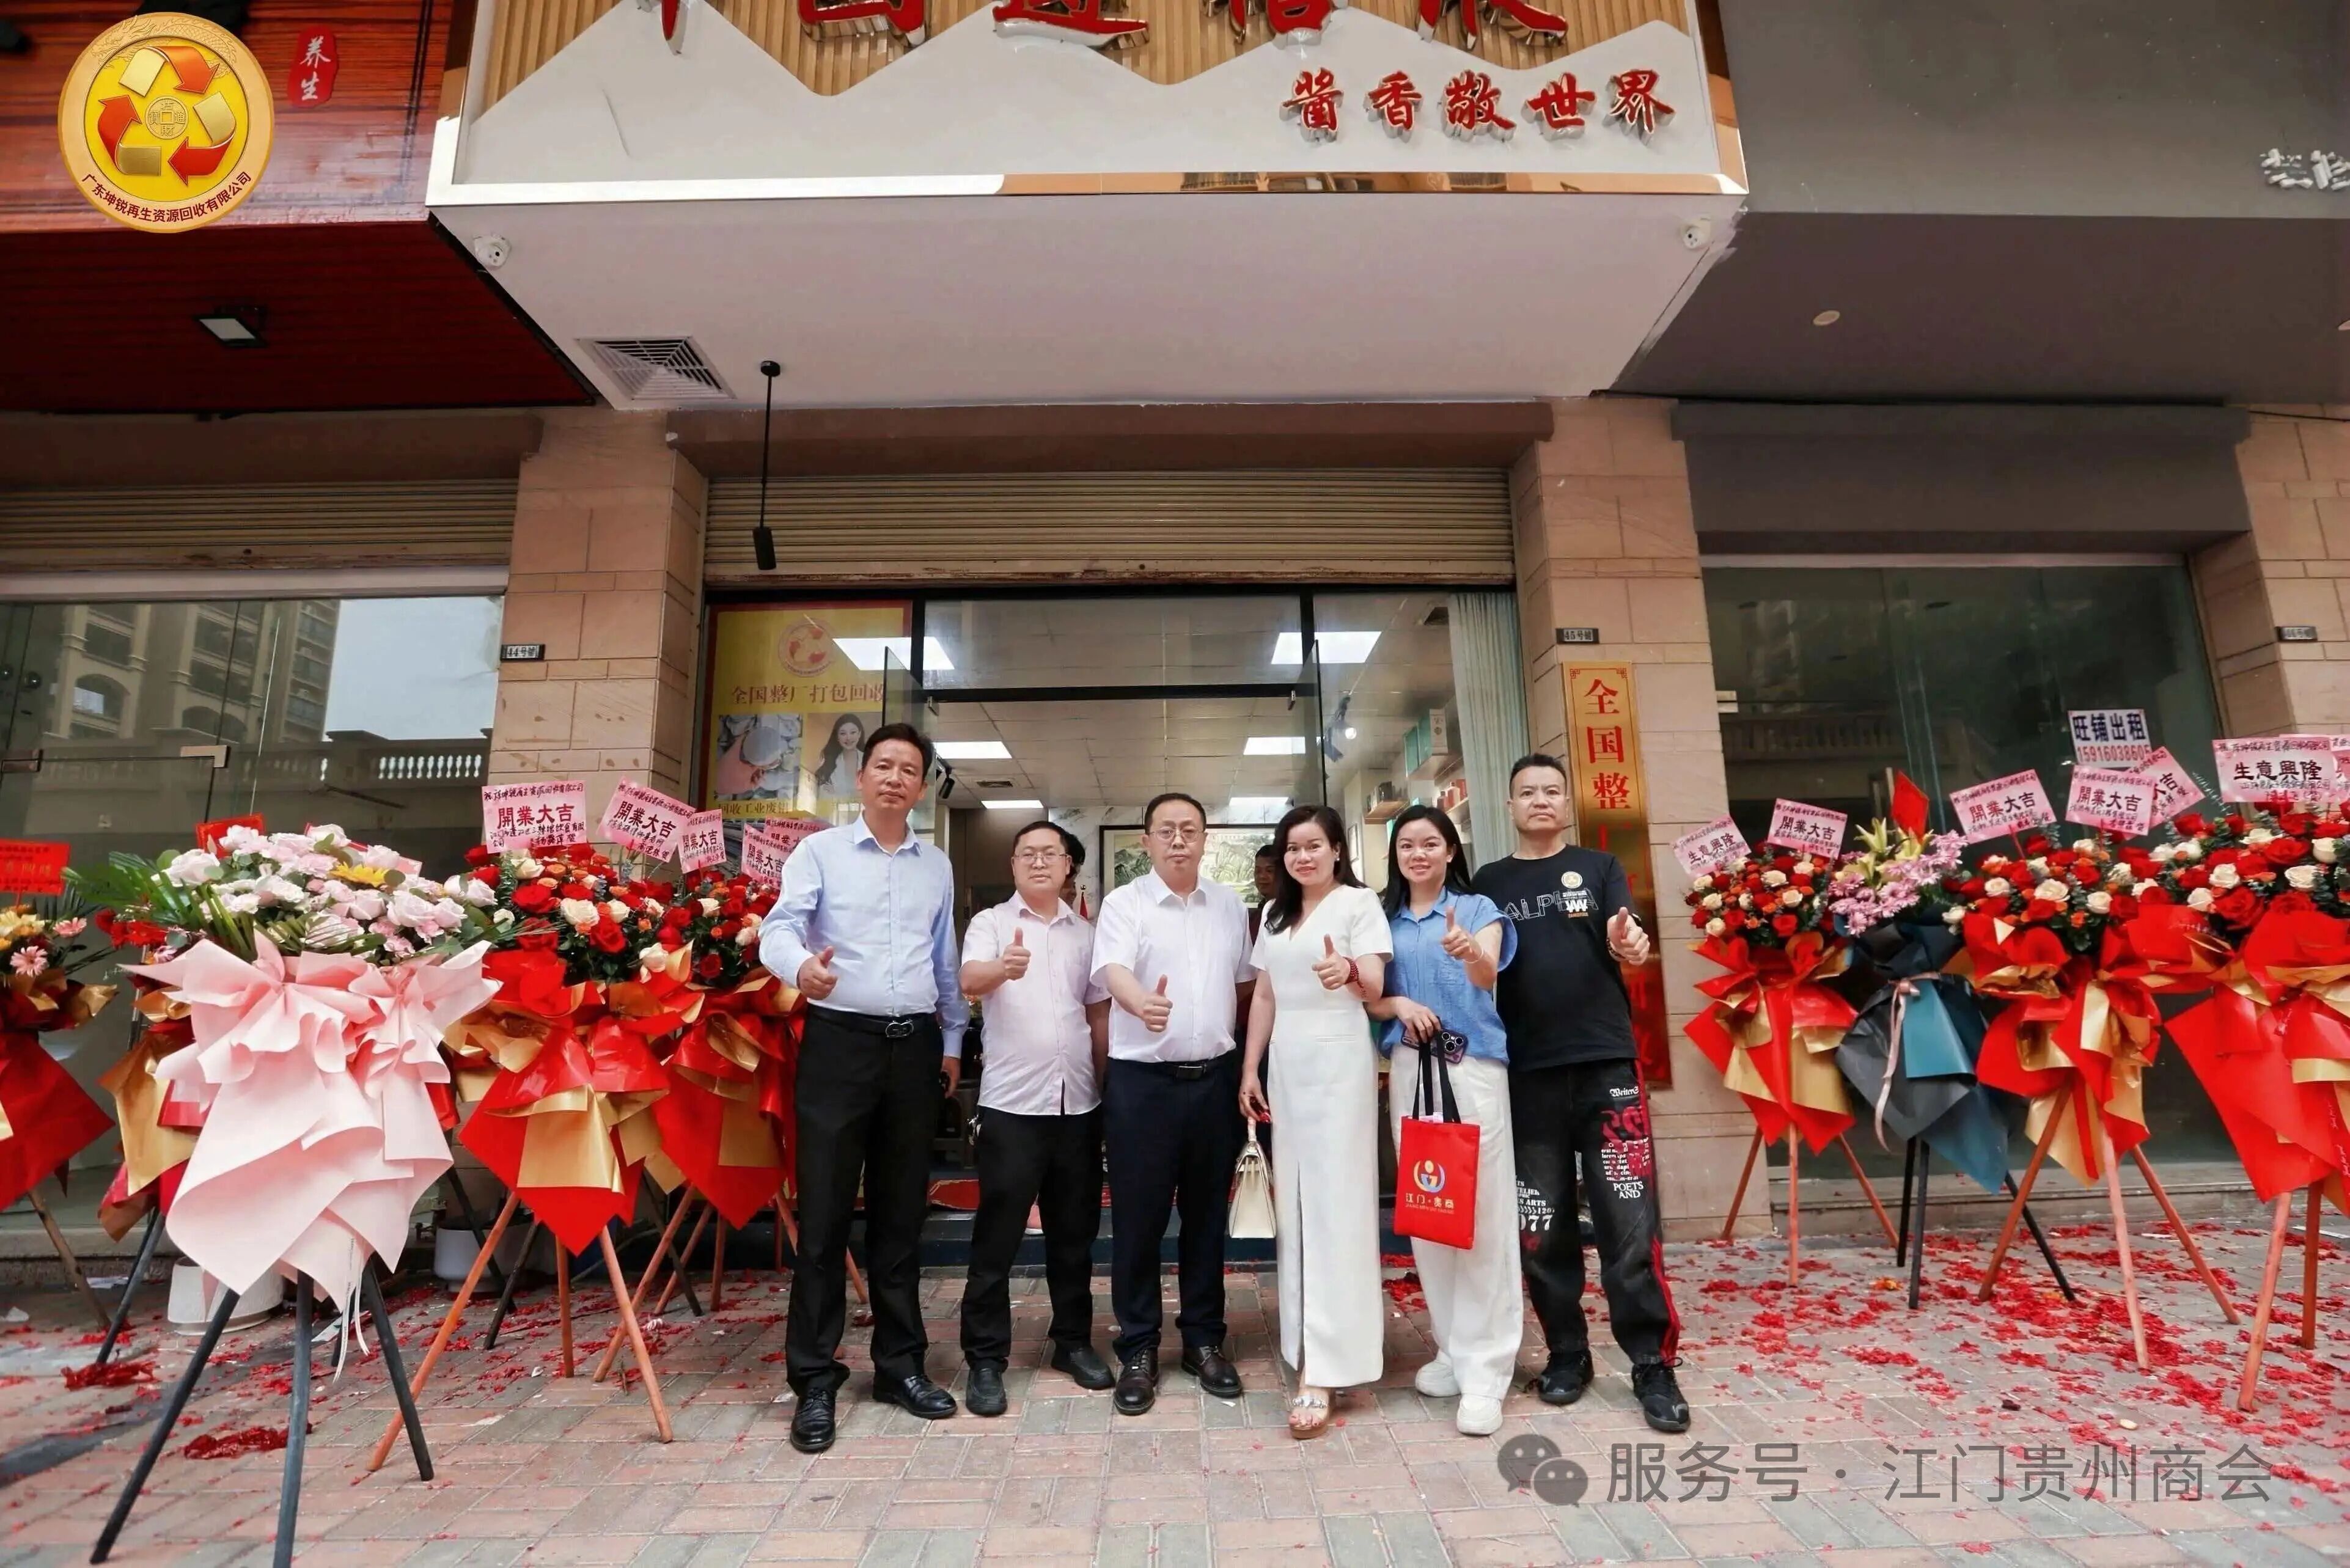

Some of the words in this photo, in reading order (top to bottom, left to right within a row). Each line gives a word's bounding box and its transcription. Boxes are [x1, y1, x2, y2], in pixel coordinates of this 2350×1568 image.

[299, 35, 331, 101] 养生
[2072, 713, 2146, 742] 旺铺出租
[2233, 760, 2322, 781] 生意興隆
[1969, 792, 2035, 824] 開業大吉
[2077, 786, 2142, 811] 開業大吉
[497, 803, 575, 829] 開業大吉
[614, 800, 677, 838] 開業大吉
[1779, 816, 1836, 841] 開業大吉
[1614, 1181, 1643, 1191] POETS
[1619, 1190, 1640, 1198] AND
